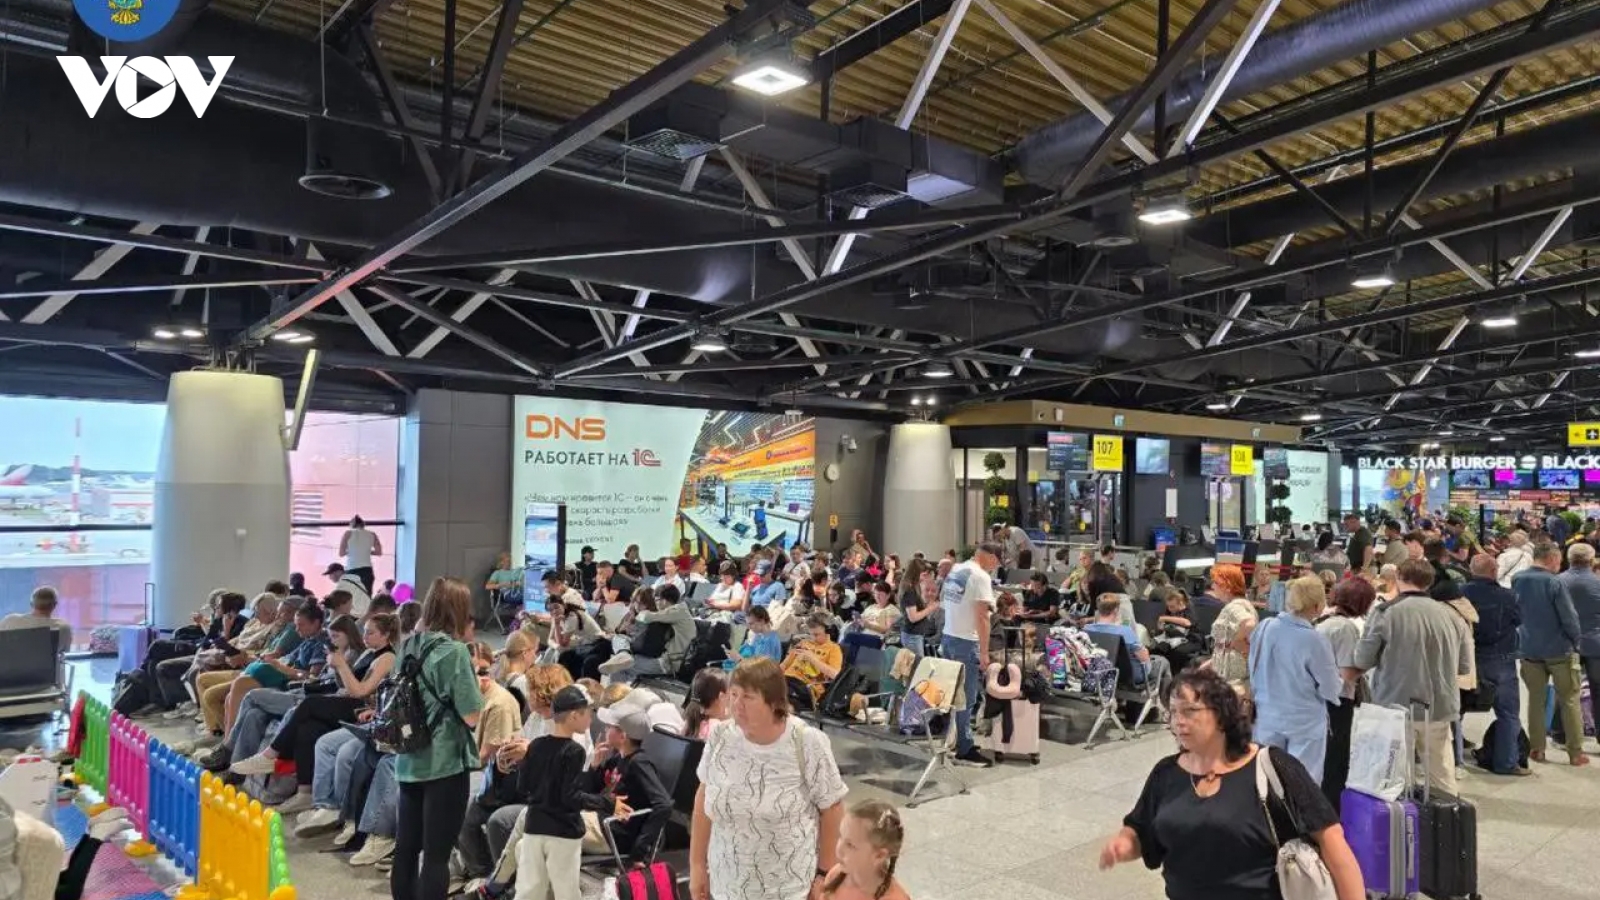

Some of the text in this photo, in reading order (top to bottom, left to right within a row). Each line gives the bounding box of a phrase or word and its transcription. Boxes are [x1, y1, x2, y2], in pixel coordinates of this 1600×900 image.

[526, 414, 606, 441] DNS
[1096, 441, 1114, 455] 107
[525, 450, 604, 466] РАБОТАЕТ
[608, 453, 629, 466] НА
[1358, 456, 1517, 470] BLACK STAR BURGER
[1542, 455, 1600, 469] BLACK
